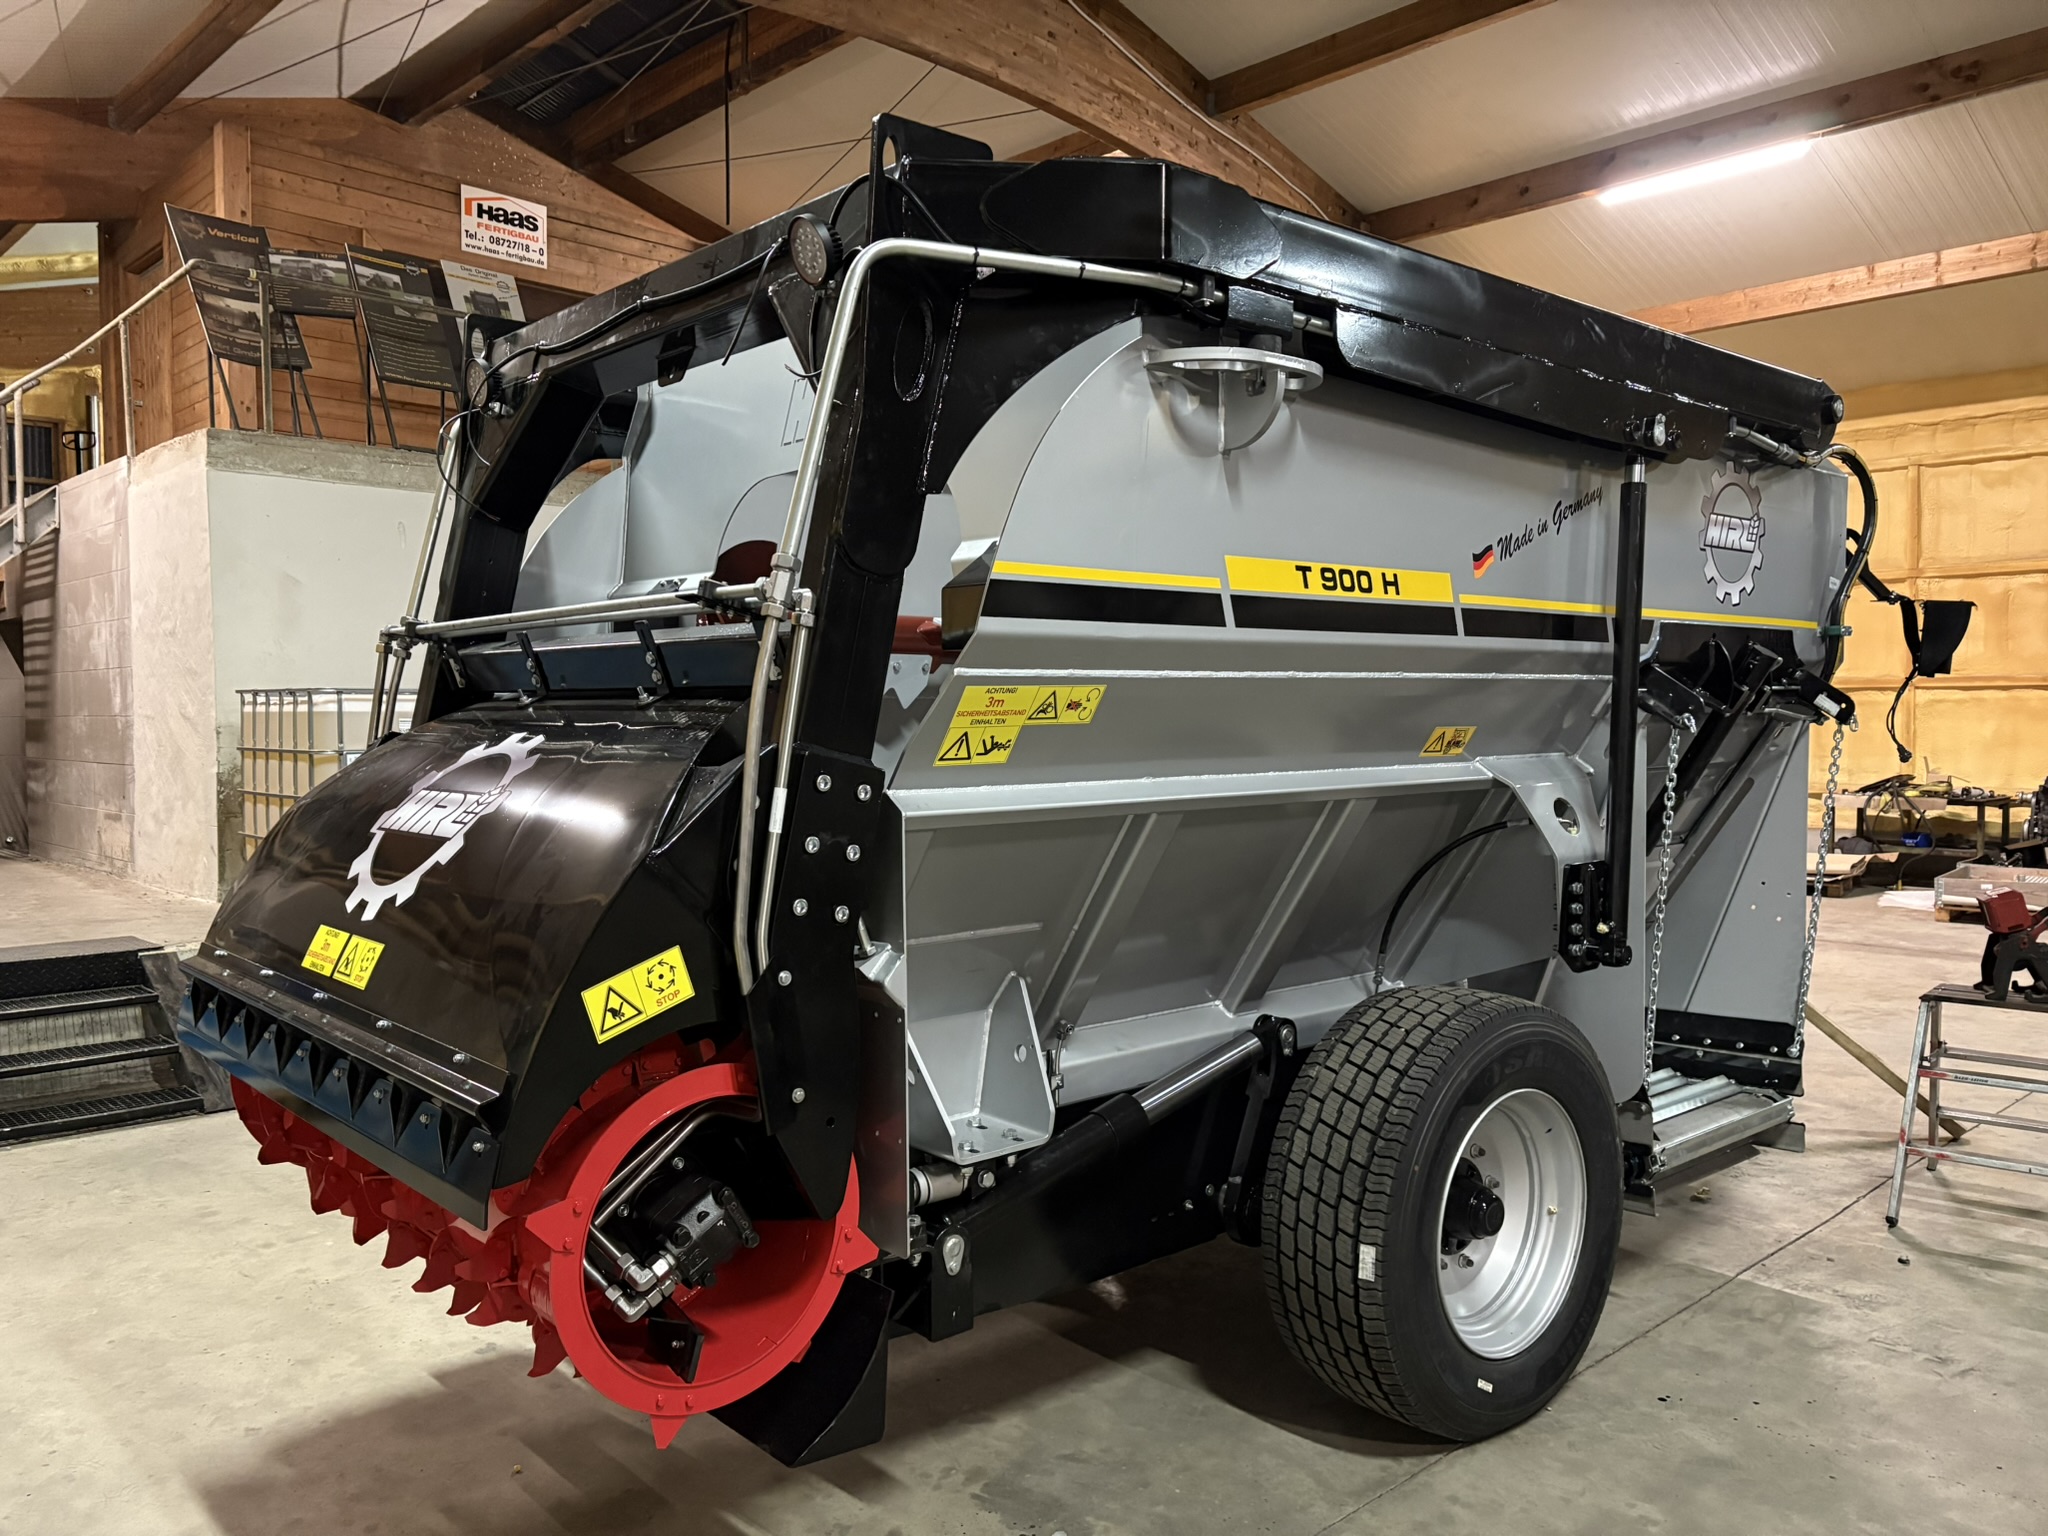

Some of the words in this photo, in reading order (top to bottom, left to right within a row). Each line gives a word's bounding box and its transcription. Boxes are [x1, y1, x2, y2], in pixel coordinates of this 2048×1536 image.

[476, 202, 539, 232] Haas
[207, 226, 259, 244] Vertical
[464, 229, 485, 243] Tel.:
[476, 221, 539, 243] FERTIGBAU
[1496, 523, 1535, 562] Made
[1537, 517, 1549, 537] in
[1552, 485, 1604, 536] Germany
[1295, 564, 1312, 590] T
[1320, 566, 1373, 594] 900
[1381, 571, 1400, 596] H
[984, 686, 1019, 695] ACHTUNG!
[984, 696, 1005, 708] 3m
[955, 708, 1027, 718] SICHERHEITSABSTAND
[969, 718, 1007, 726] EINHALTEN
[655, 988, 681, 1007] STOP
